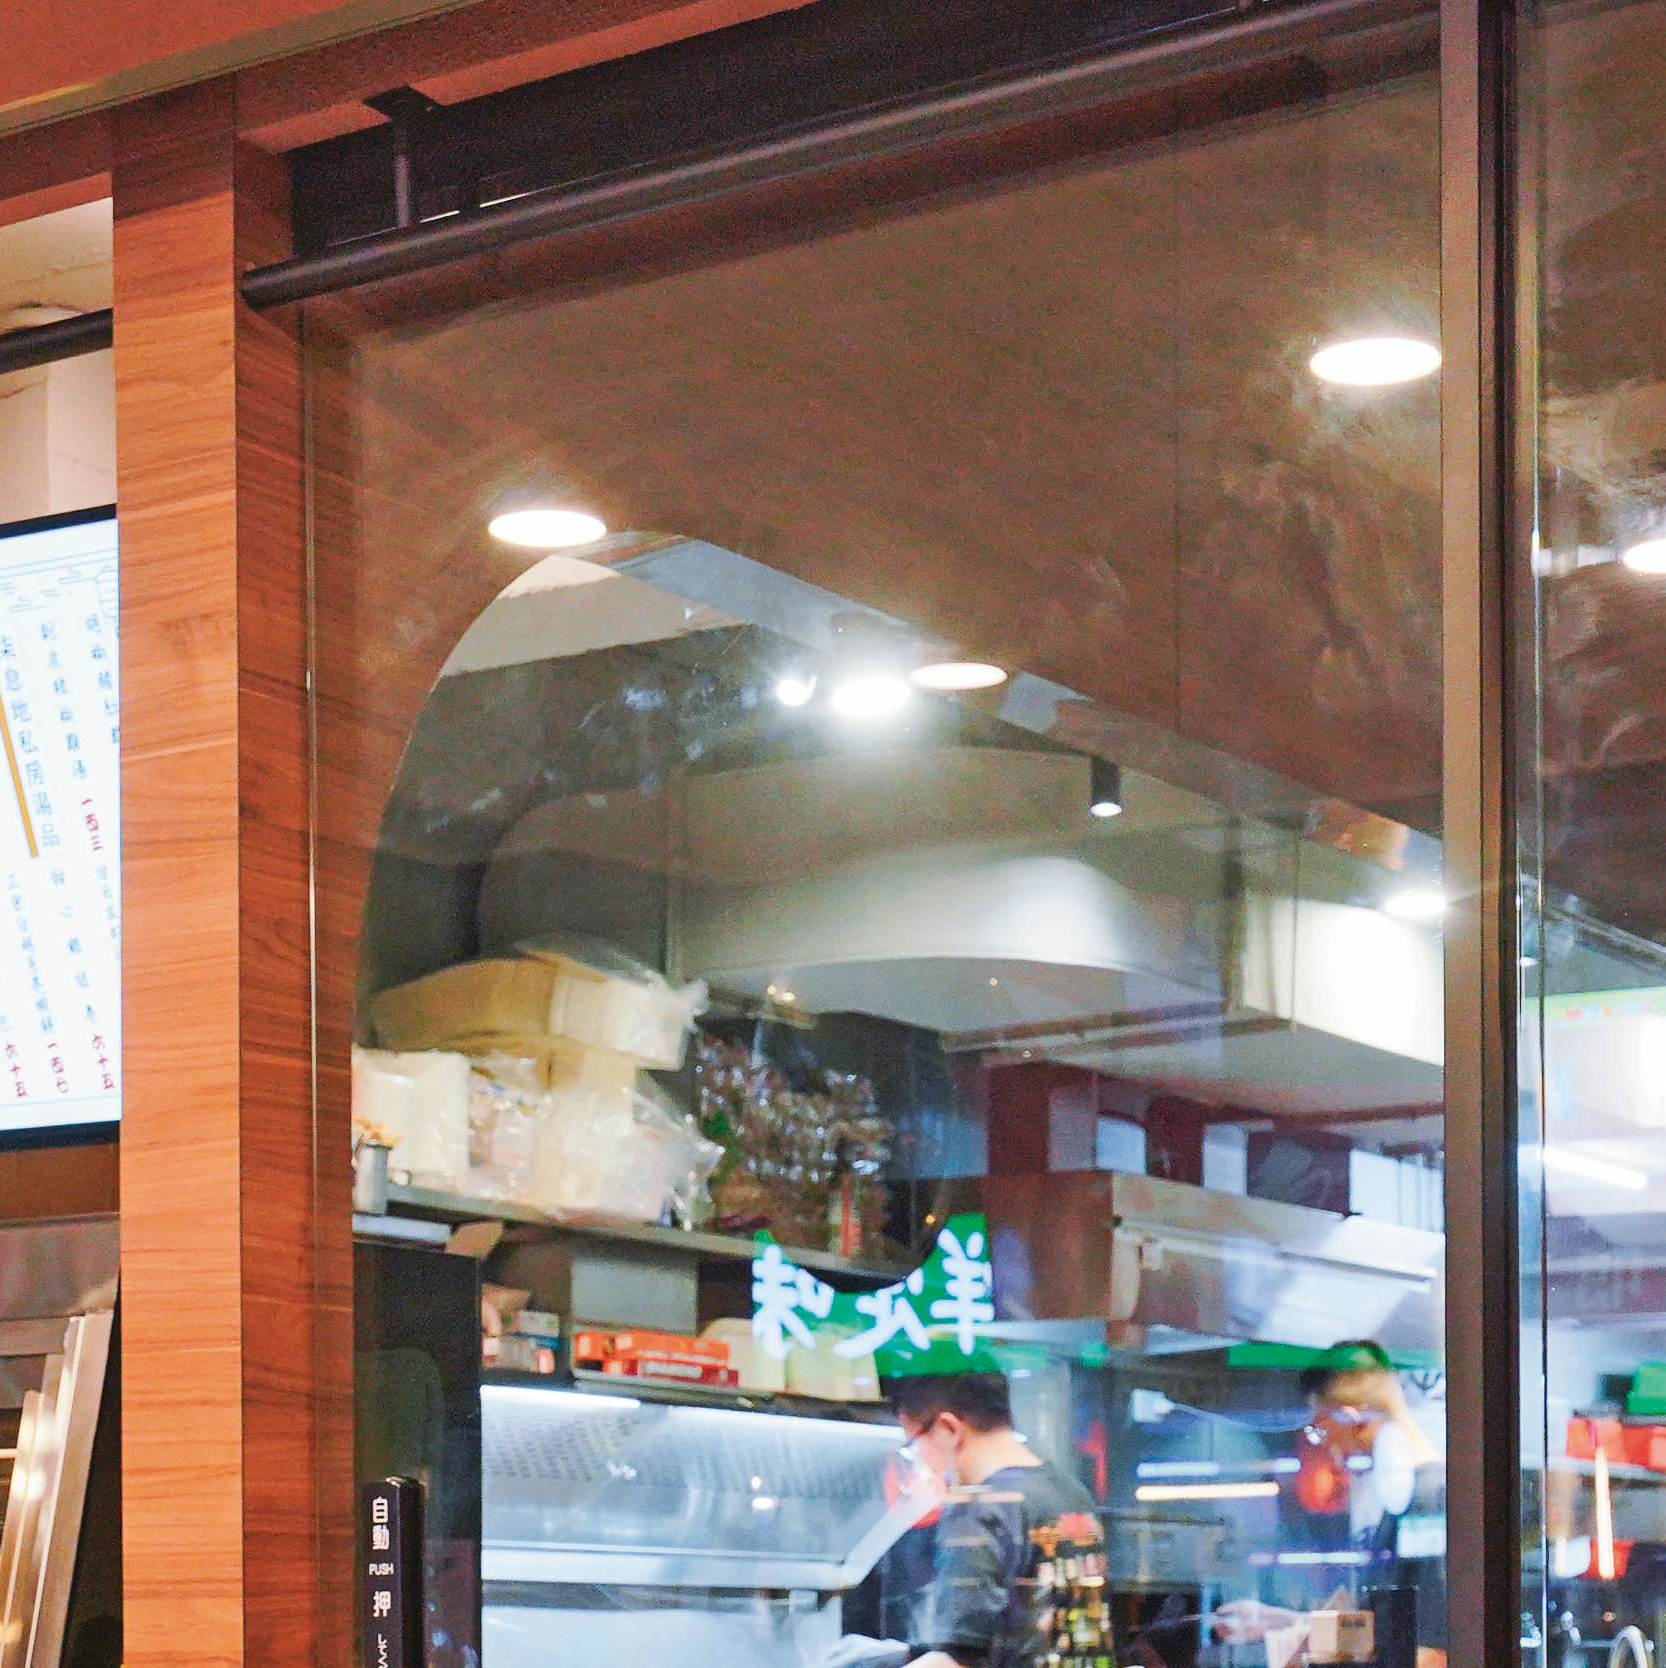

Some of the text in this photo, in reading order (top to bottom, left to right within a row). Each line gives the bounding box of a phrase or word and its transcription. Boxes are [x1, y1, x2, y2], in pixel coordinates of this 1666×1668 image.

[372, 1496, 390, 1551] 自動
[368, 1562, 394, 1576] PUSH
[373, 1591, 392, 1618] 押
